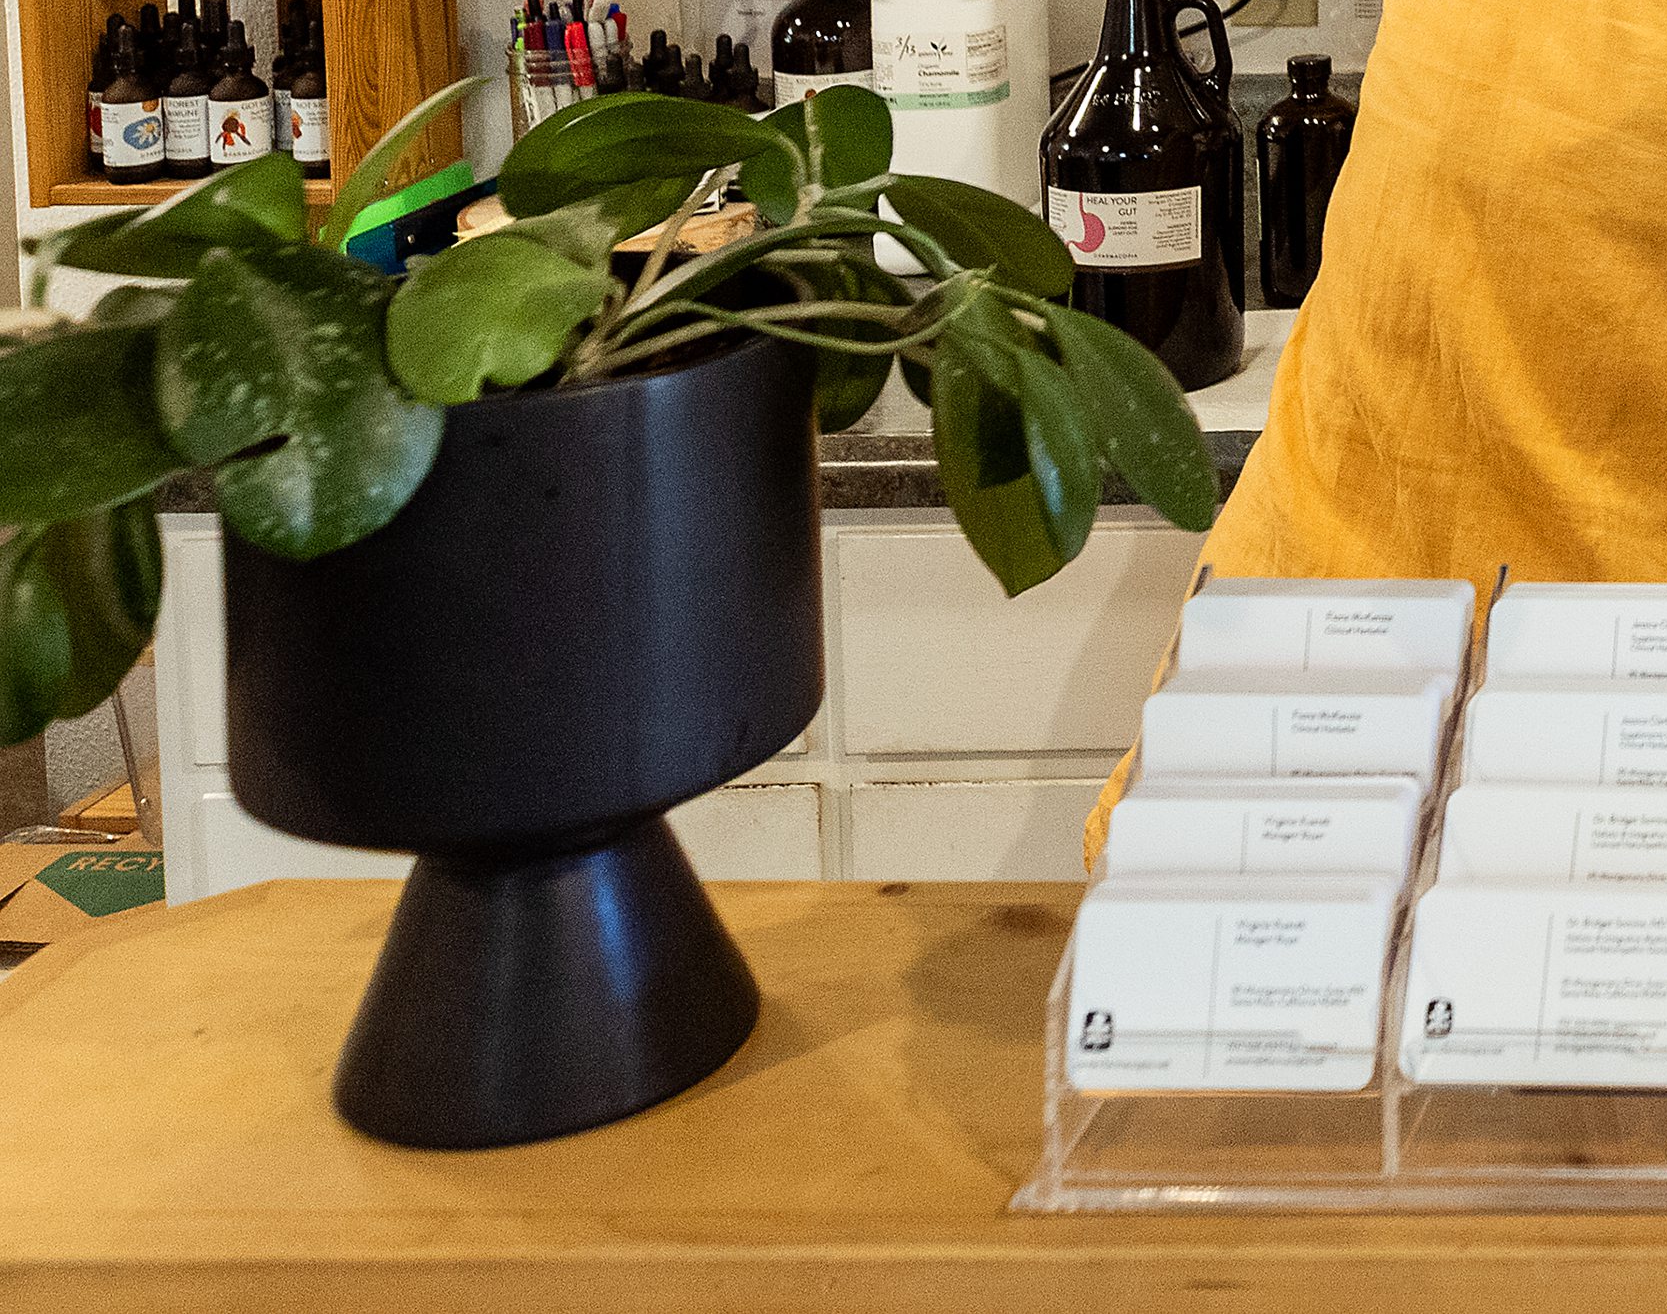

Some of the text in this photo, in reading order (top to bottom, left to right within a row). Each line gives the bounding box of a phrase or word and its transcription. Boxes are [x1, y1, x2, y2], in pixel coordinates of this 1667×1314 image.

[1086, 196, 1137, 205] HEAL YOUR
[1119, 207, 1137, 216] GUT
